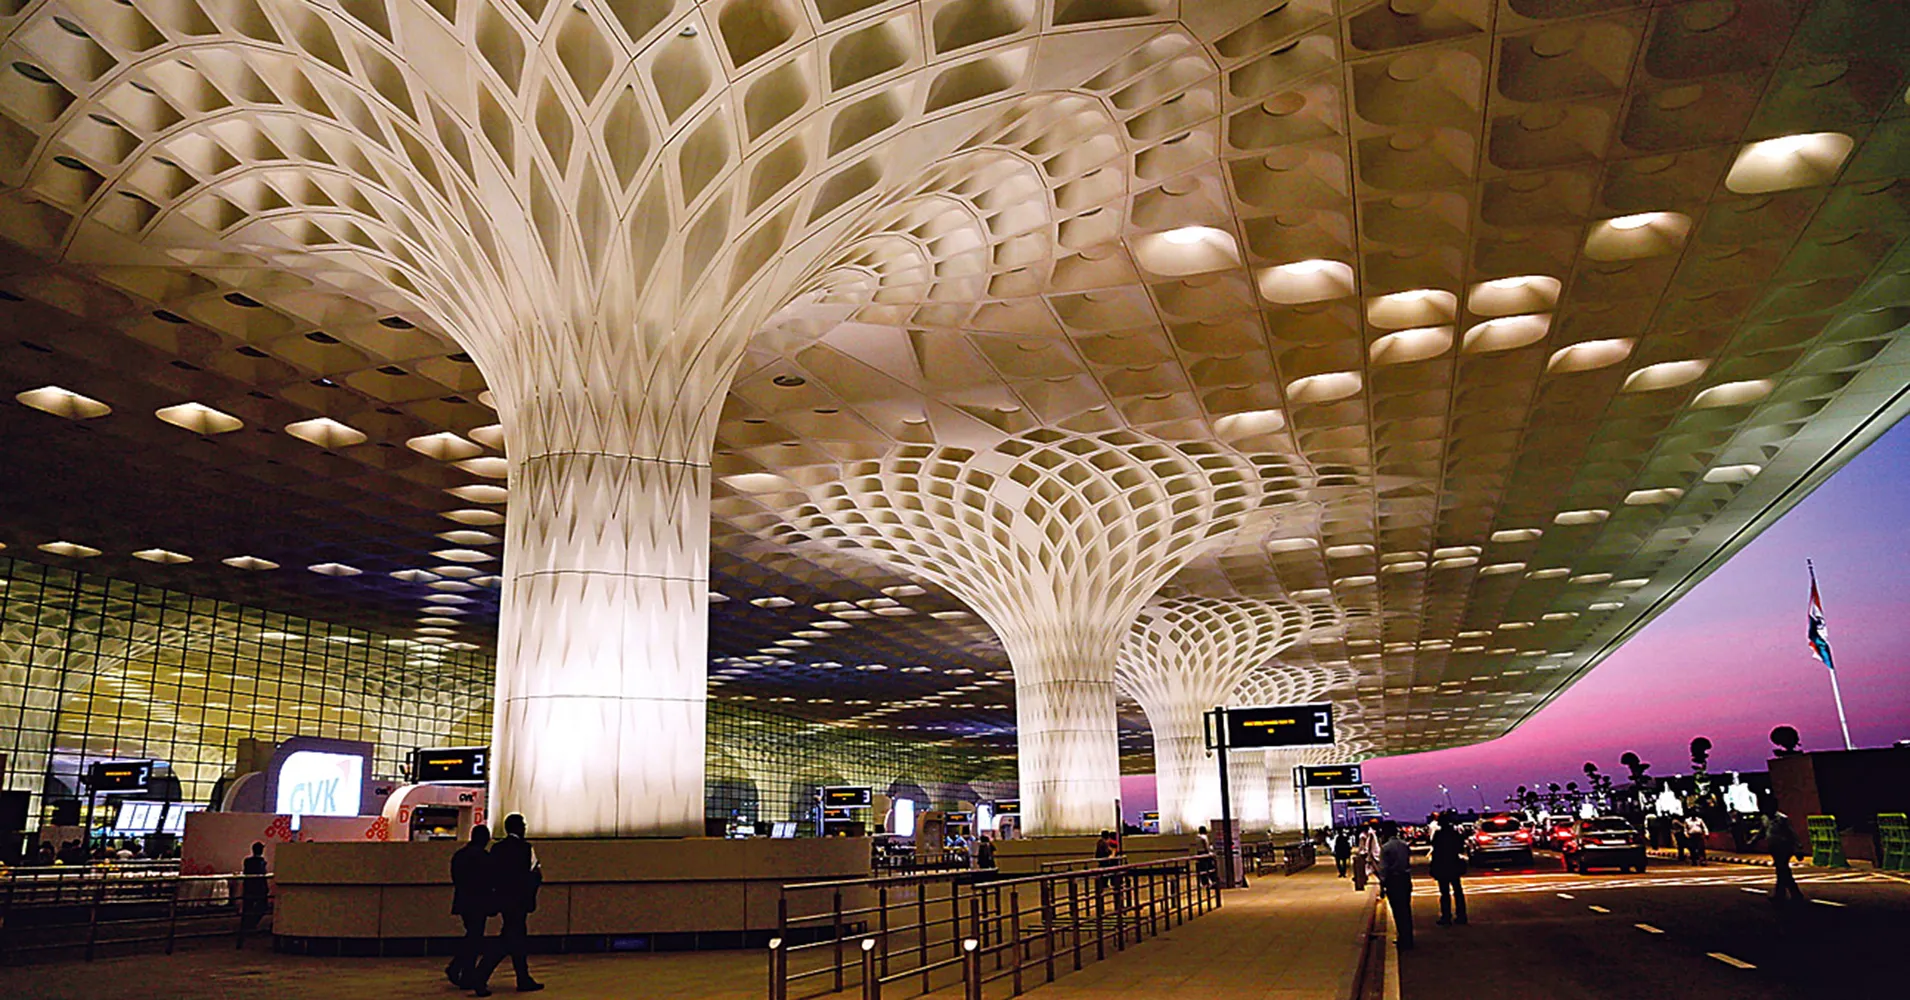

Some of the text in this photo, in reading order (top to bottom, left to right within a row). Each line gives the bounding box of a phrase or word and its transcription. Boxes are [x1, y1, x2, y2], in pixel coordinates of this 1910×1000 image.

[1313, 712, 1329, 737] 2
[472, 754, 484, 775] 2
[138, 767, 148, 785] 2
[1350, 768, 1360, 783] 3
[290, 778, 339, 813] GVK
[863, 790, 871, 803] 3
